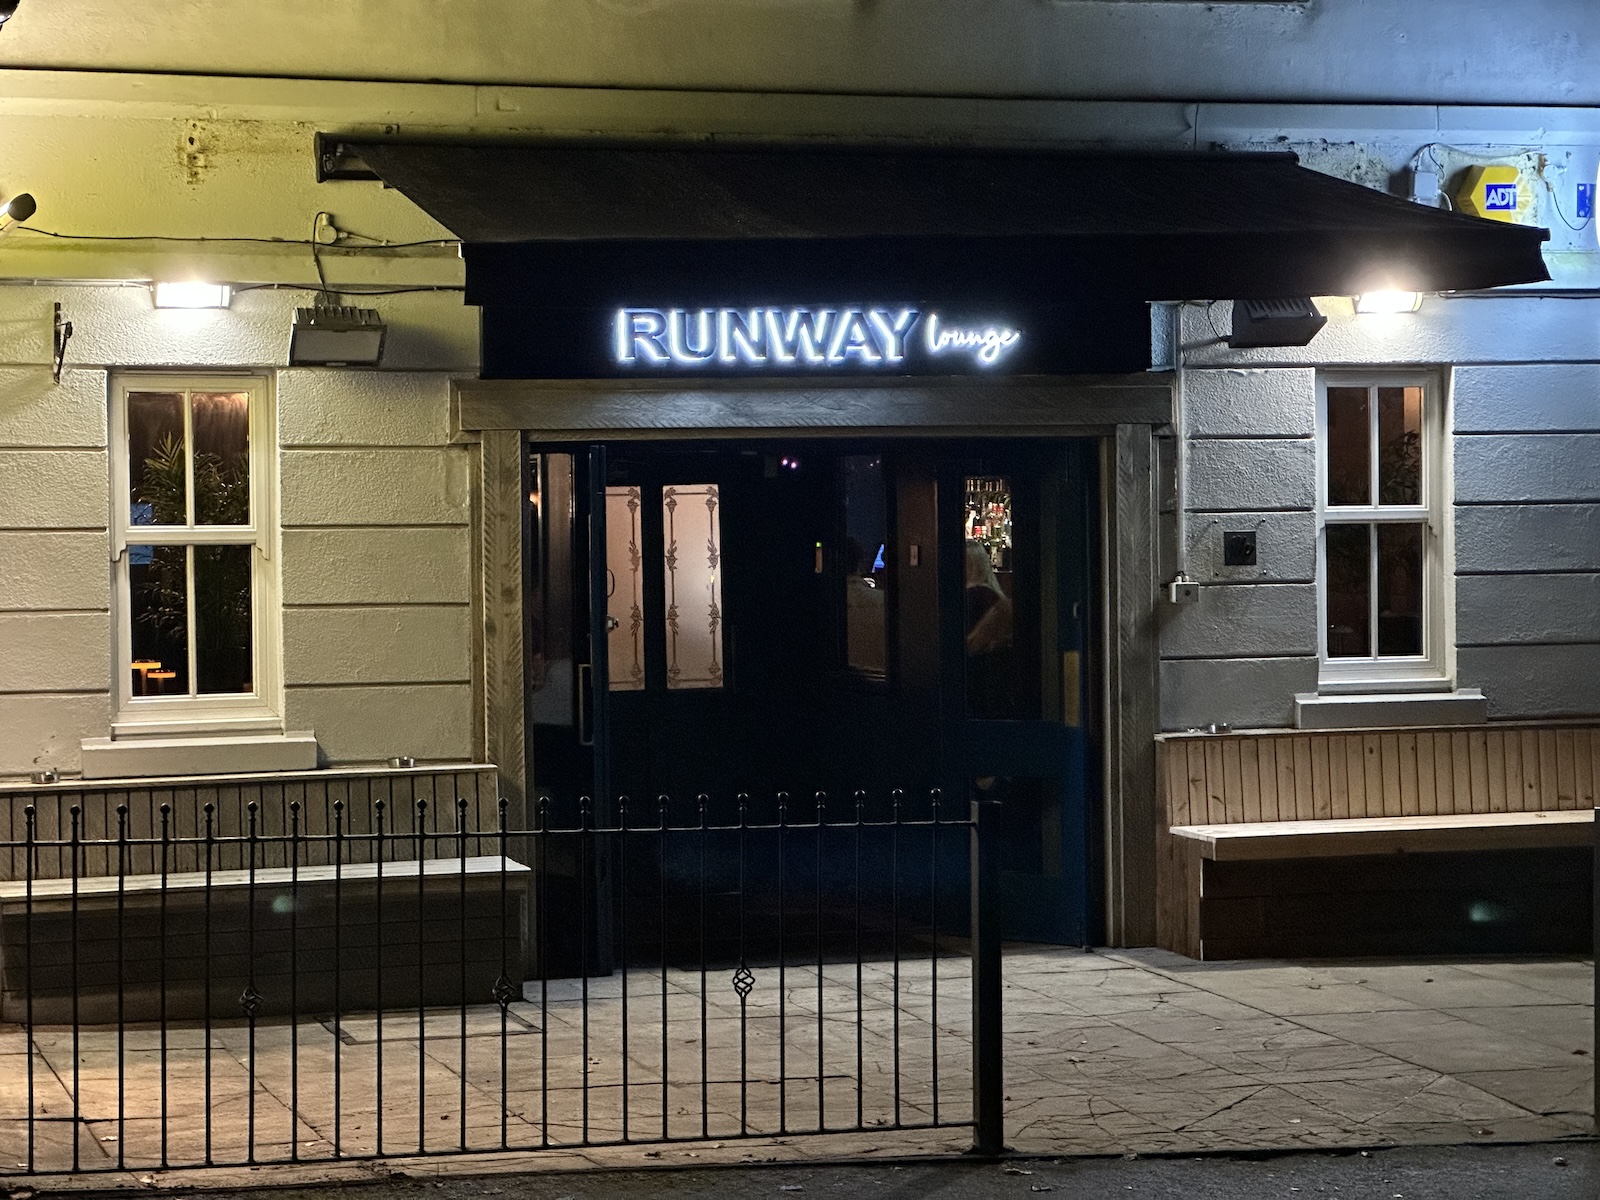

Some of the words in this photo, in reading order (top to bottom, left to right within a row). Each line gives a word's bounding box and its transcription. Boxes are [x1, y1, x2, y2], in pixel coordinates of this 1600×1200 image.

[1486, 188, 1515, 206] ADT
[616, 308, 919, 361] RUNWAY
[927, 313, 1020, 363] lounge
